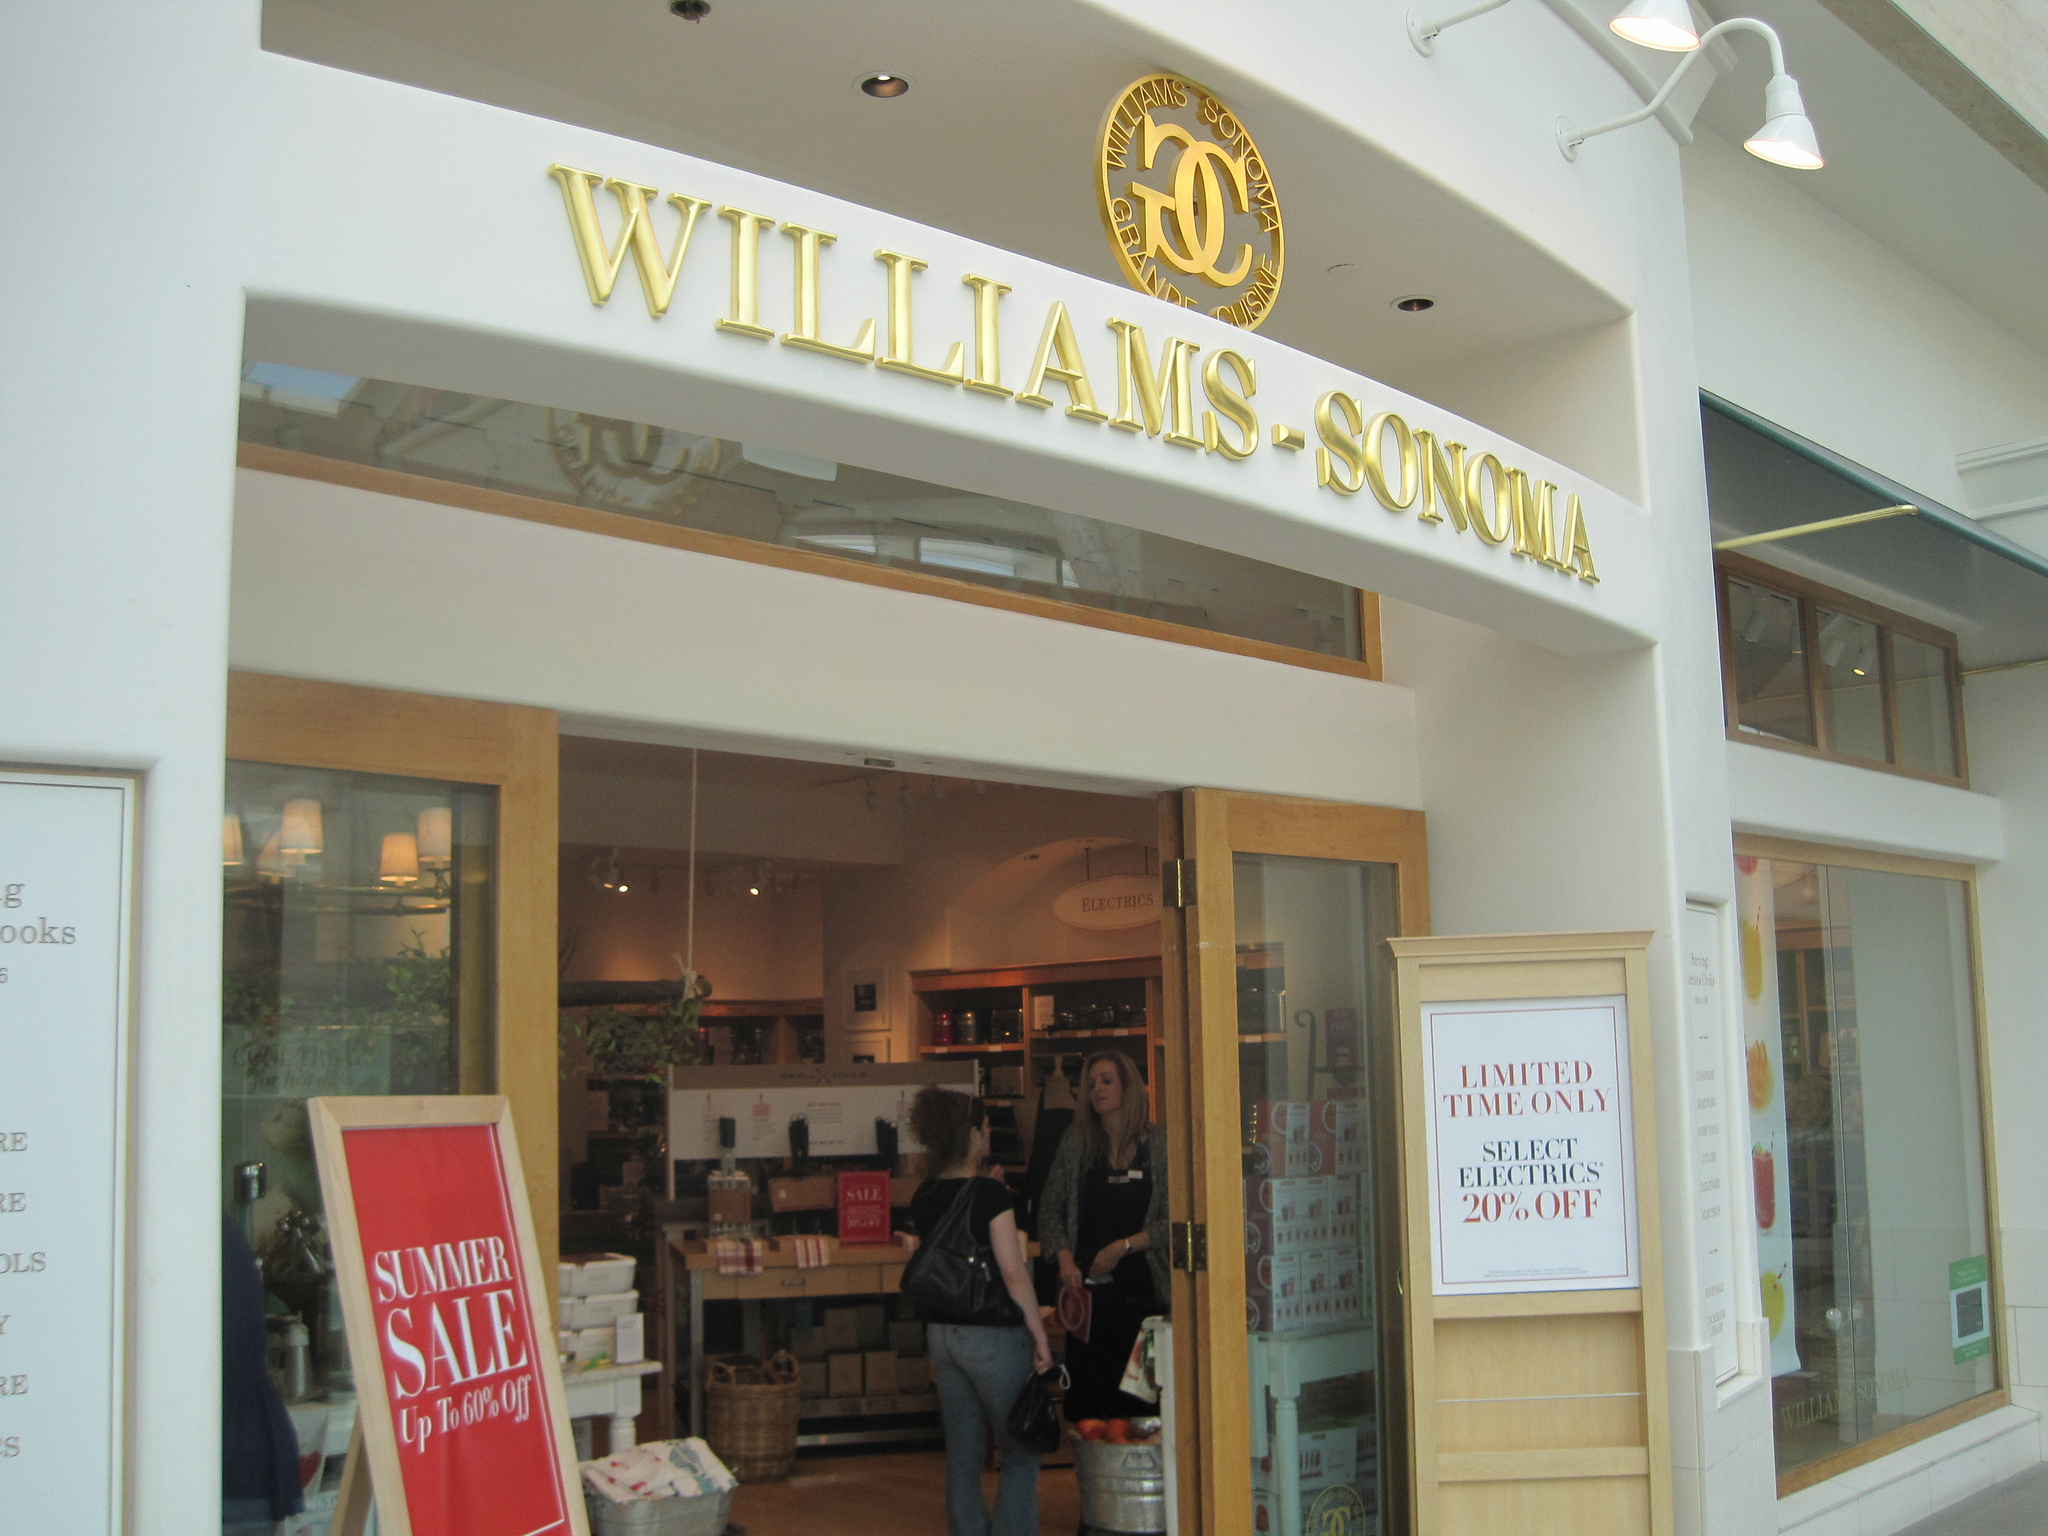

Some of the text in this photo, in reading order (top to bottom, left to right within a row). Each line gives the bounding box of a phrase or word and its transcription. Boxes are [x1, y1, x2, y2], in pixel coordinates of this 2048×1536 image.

[1105, 78, 1281, 234] WILLIAMS SONOMA
[547, 163, 1260, 461] WILLIAMS
[1315, 390, 1601, 585] SONOMA
[1081, 893, 1154, 912] ELECTRICS
[0, 916, 77, 945] ooks
[1460, 1060, 1594, 1089] LIMITED
[1443, 1088, 1612, 1118] TIME ONLY
[1482, 1137, 1579, 1163] SELECT
[1462, 1188, 1602, 1224] 20% OFF
[373, 1236, 514, 1303] SUMMER
[387, 1289, 529, 1399] SALE
[400, 1374, 532, 1453] Up To 60% Off
